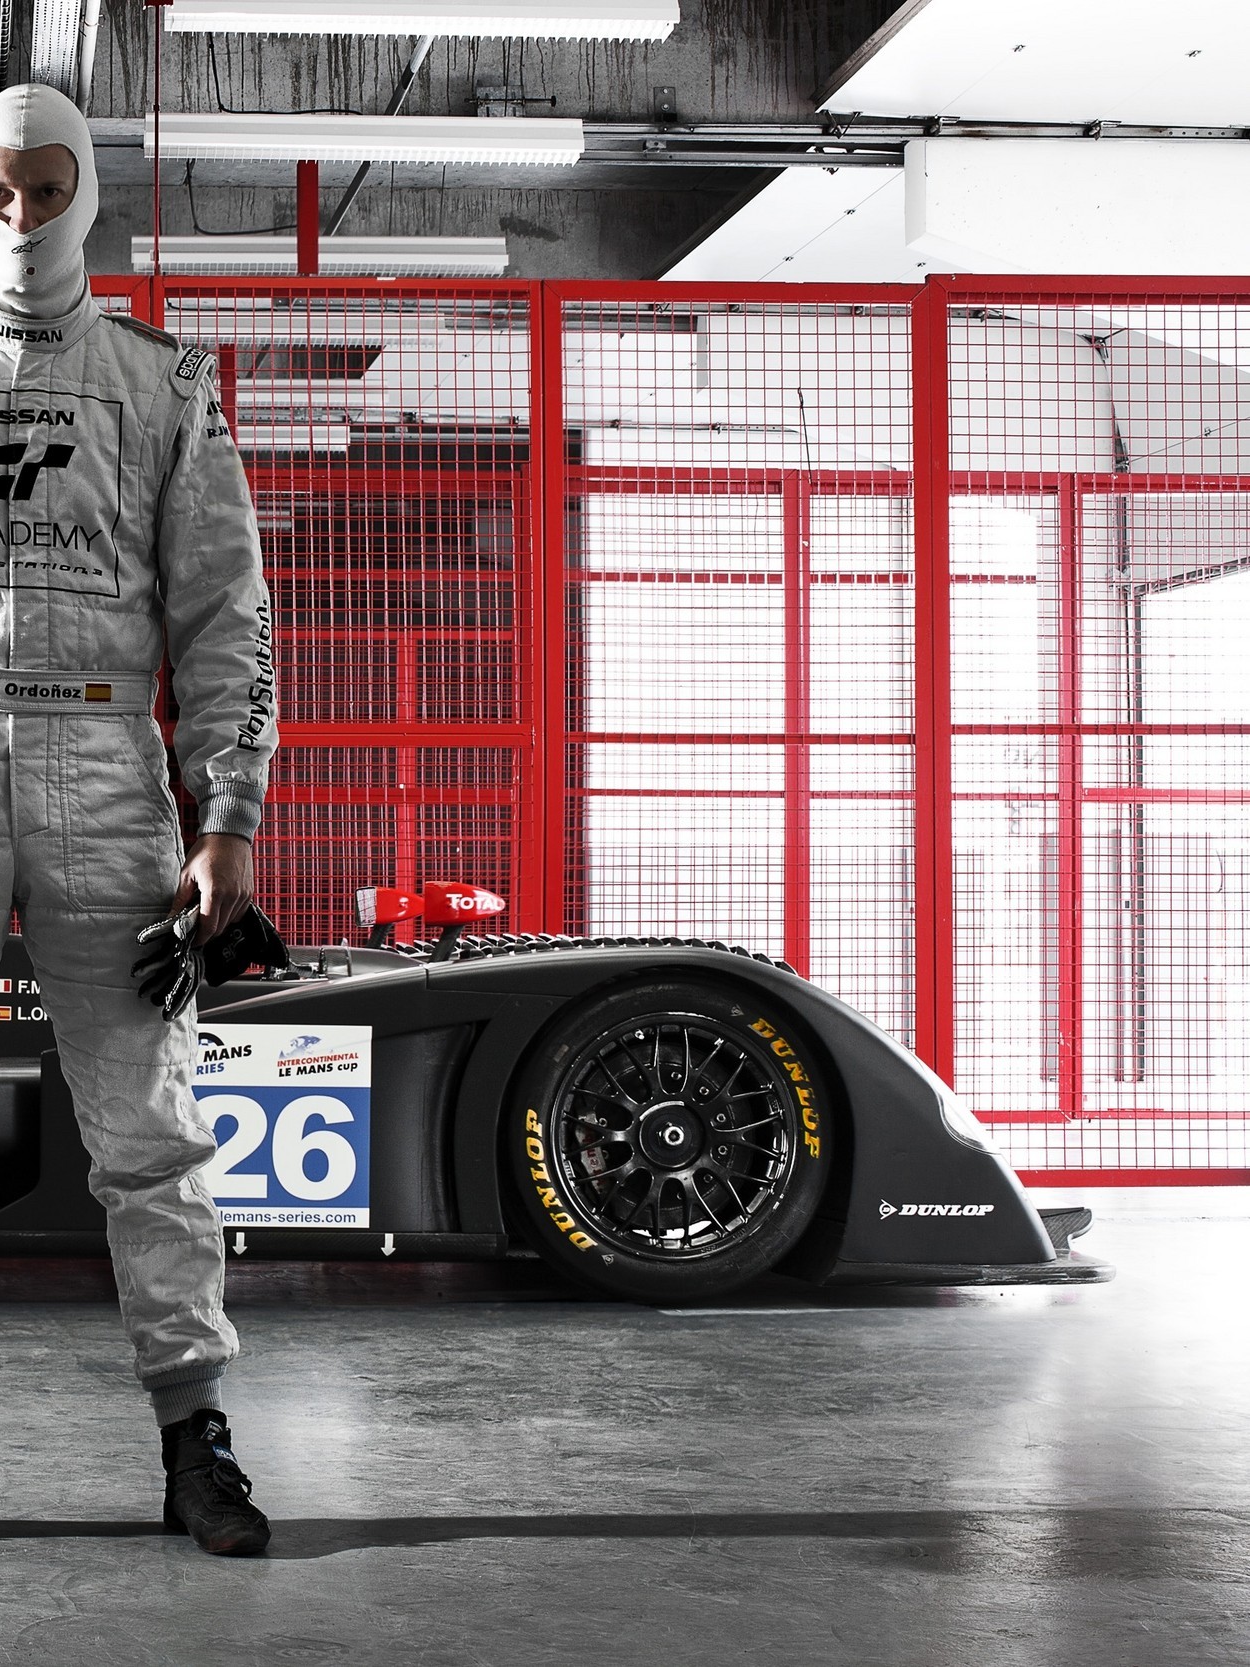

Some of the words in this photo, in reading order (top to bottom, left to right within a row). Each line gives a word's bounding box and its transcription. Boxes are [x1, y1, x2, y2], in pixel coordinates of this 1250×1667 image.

[4, 682, 82, 699] Ordoñez
[446, 893, 504, 912] TOTAL
[203, 1045, 252, 1062] MANS
[277, 1052, 359, 1068] INTERCONTINENTAL
[278, 1067, 292, 1078] LE
[296, 1063, 333, 1076] MANS
[197, 1094, 357, 1201] 26
[525, 1108, 598, 1252] DUNLOP
[898, 1204, 994, 1216] DUNLOP
